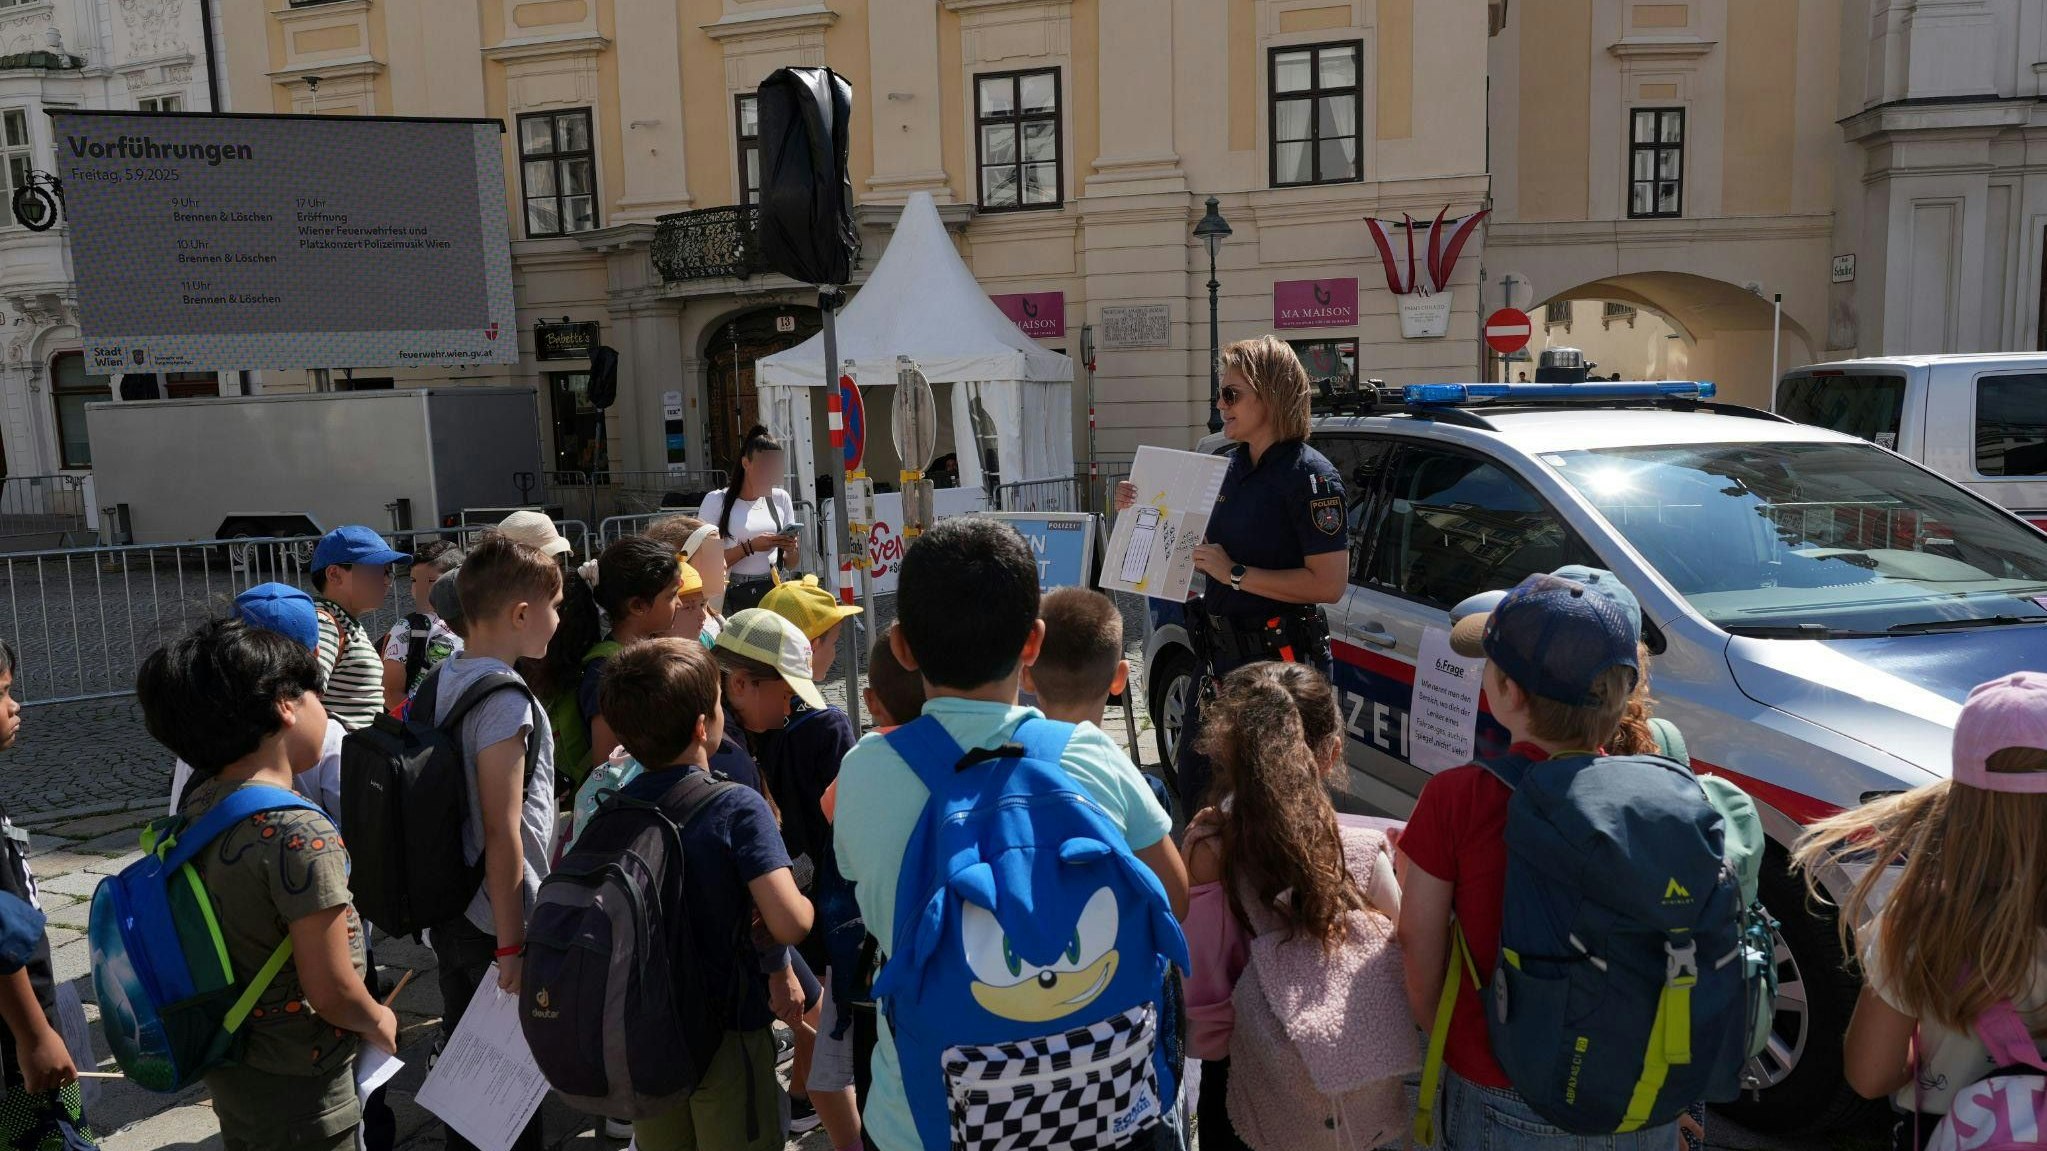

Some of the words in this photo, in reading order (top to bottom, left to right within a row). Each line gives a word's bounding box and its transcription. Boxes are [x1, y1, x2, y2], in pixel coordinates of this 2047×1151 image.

[68, 136, 253, 166] Vorführungen
[72, 168, 122, 182] Freitag,
[126, 168, 179, 181] 5.9.2025
[172, 198, 178, 207] 9
[180, 198, 199, 207] Uhr
[296, 199, 305, 208] 17
[308, 199, 326, 208] Uhr
[173, 212, 217, 222] Brennen
[219, 212, 227, 222] &
[231, 212, 273, 222] Löschen
[297, 212, 347, 224] Eröffnung
[298, 226, 334, 236] Wiener
[336, 226, 407, 236] Feuerwehrfest
[409, 226, 428, 235] und
[177, 240, 188, 249] 10
[190, 240, 208, 249] Uhr
[300, 239, 362, 250] Platzkonzert
[364, 239, 424, 249] Polizeimusik
[426, 239, 450, 249] Wien
[178, 253, 222, 263] Brennen
[224, 253, 232, 263] &
[235, 253, 277, 263] Löschen
[182, 281, 190, 290] 11
[192, 281, 211, 290] Uhr
[183, 295, 226, 305] Brennen
[228, 294, 236, 304] &
[239, 294, 281, 304] Löschen
[1281, 309, 1300, 319] MA
[1302, 307, 1351, 318] MAISON
[780, 317, 791, 327] 13
[545, 332, 591, 344] Babette's
[94, 347, 122, 356] Stadt
[399, 349, 493, 359] feuerwehr.wien.gv.at
[95, 357, 124, 367] Wien
[1312, 499, 1339, 509] POLIZEI
[1048, 522, 1077, 530] POLIZEI
[1435, 658, 1465, 679] 6.Frage
[1421, 679, 1432, 689] Wie
[1431, 685, 1447, 695] nennt
[1447, 690, 1460, 699] man
[1460, 692, 1472, 703] den
[1448, 702, 1460, 714] dich
[1460, 707, 1471, 717] der
[1426, 709, 1445, 721] Lenker
[1445, 715, 1459, 727] eines
[1415, 730, 1434, 745] Spiegel
[531, 1007, 560, 1019] deuter
